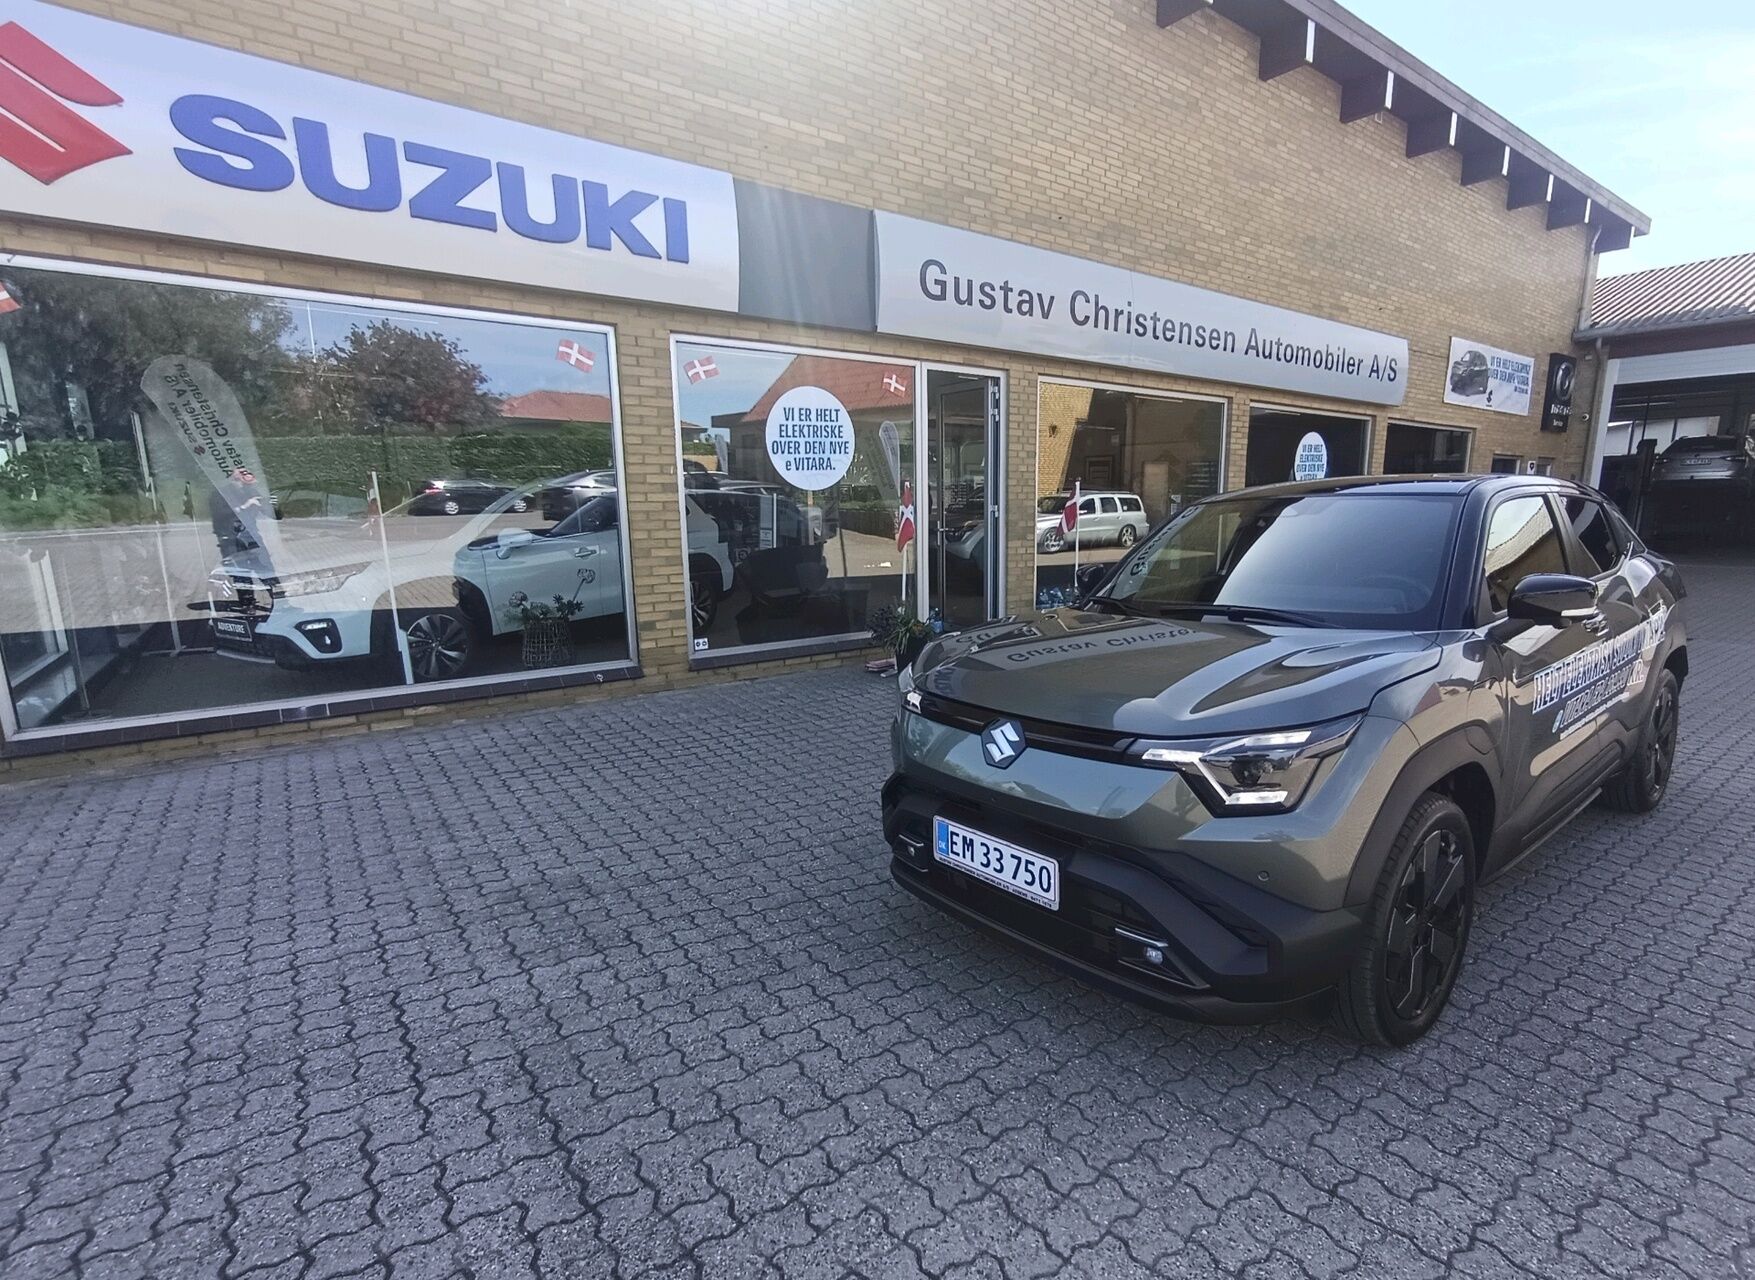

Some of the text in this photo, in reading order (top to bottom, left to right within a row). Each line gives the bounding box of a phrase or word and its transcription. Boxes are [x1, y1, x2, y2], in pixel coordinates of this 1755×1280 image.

[170, 93, 689, 263] SUZUKI
[919, 258, 1398, 383] Gustav Christensen Automobiler A/S
[783, 407, 840, 423] VI ER HELT
[779, 424, 844, 439] ELEKTRISKE
[771, 440, 849, 455] OVER DEN NYE
[785, 457, 836, 471] e VITARA.
[218, 622, 245, 633] ADVENTURE
[950, 830, 1052, 893] EM 33 750
